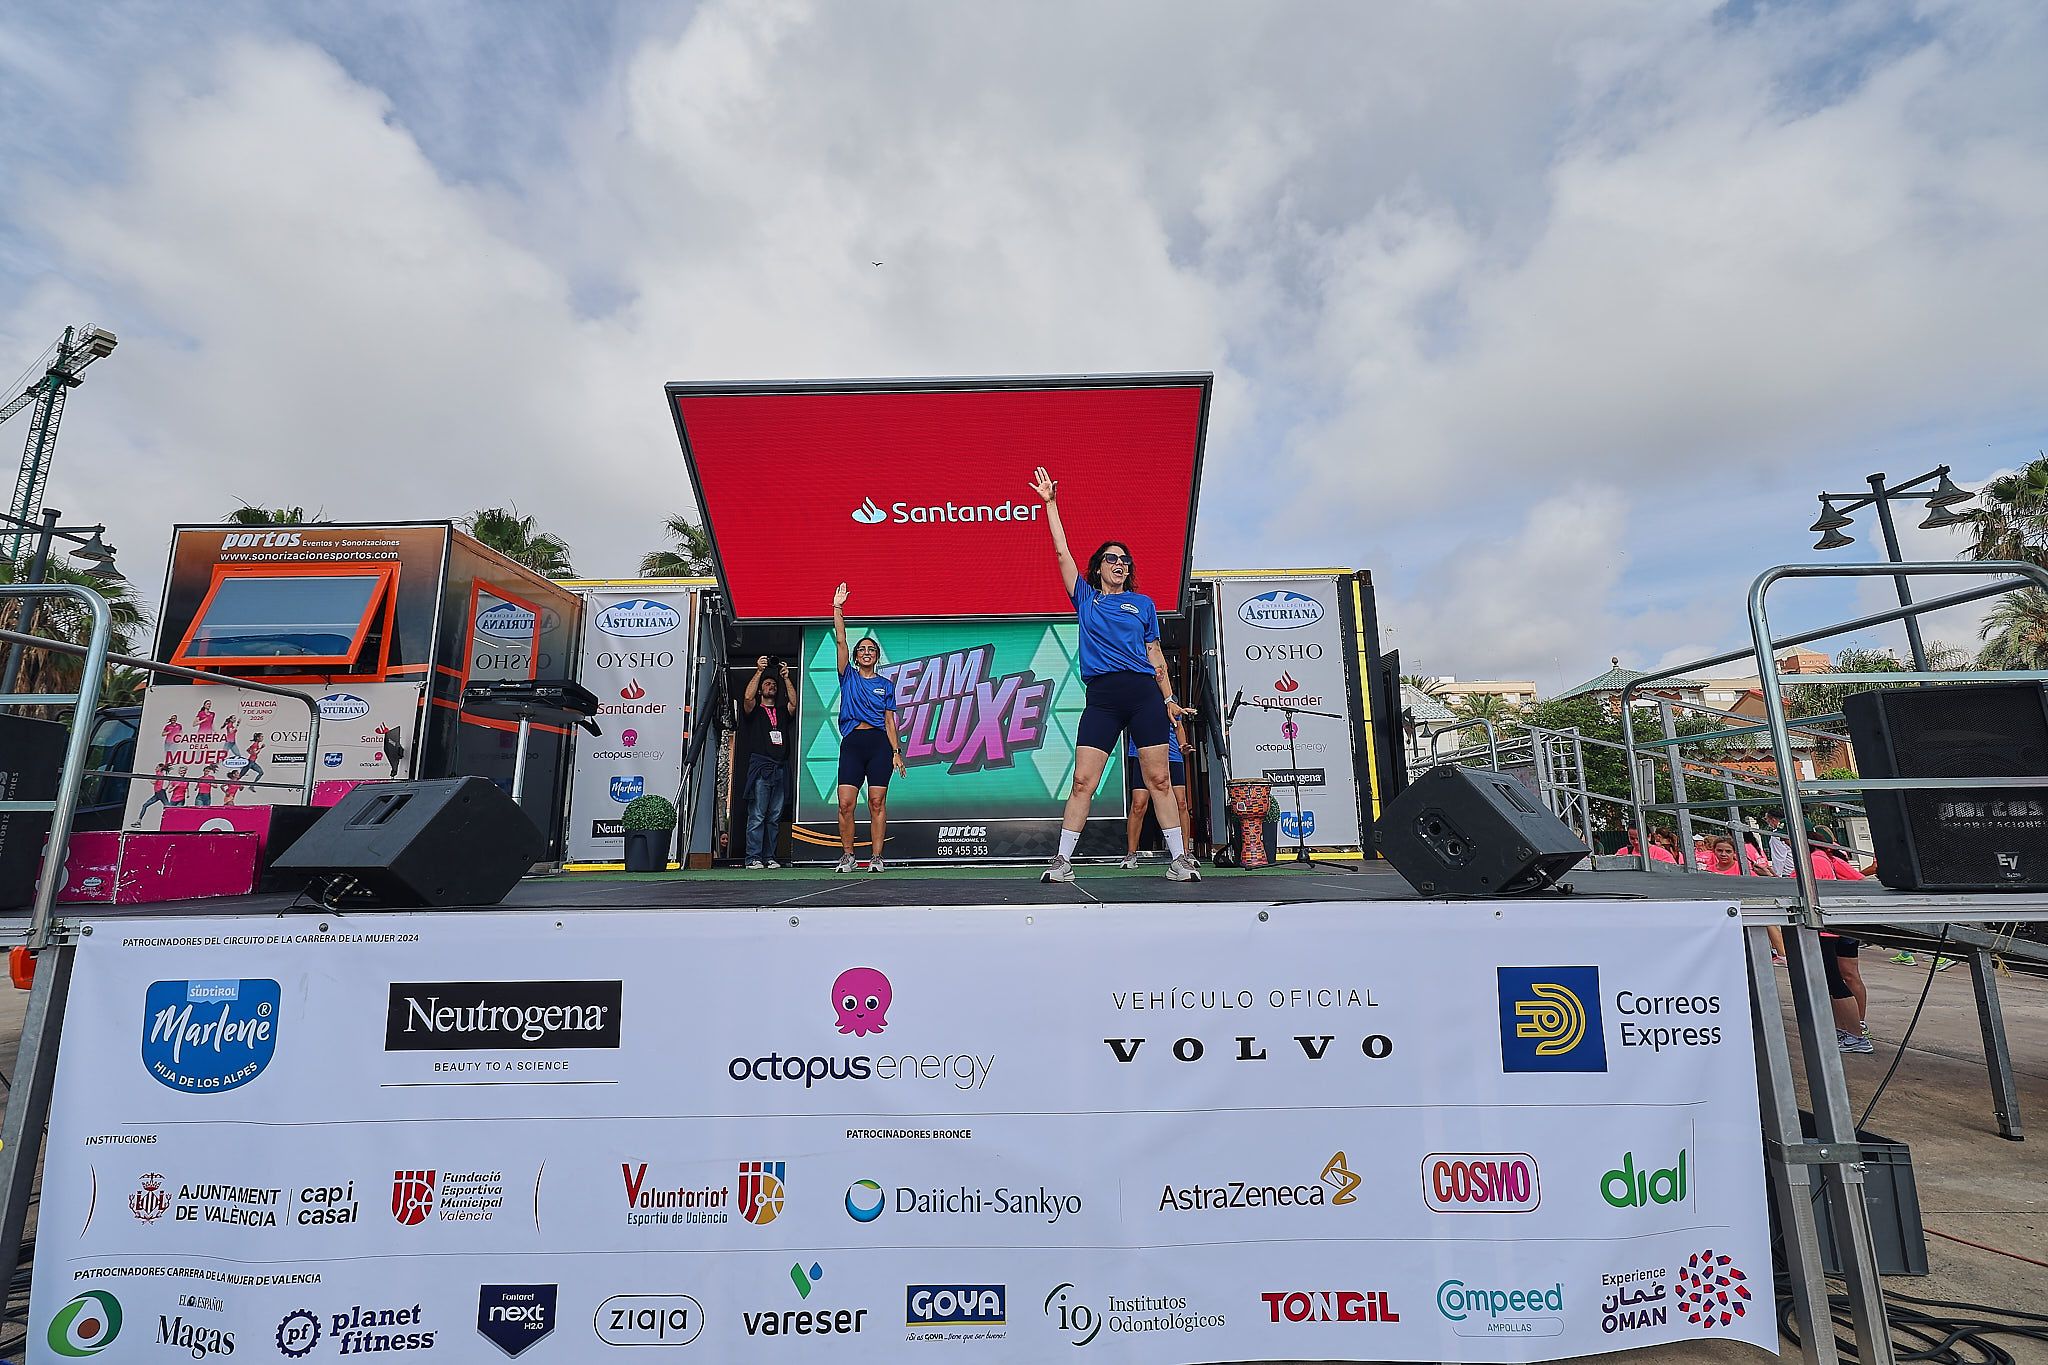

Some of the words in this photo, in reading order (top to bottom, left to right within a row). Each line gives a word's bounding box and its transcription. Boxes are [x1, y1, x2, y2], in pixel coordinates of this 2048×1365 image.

[892, 501, 1042, 523] Santander
[222, 532, 302, 550] portos
[220, 551, 398, 561] www.sonorizacionesportos.com
[600, 614, 674, 628] ASTURIANA
[1245, 605, 1318, 620] ASTURIANA
[596, 651, 674, 669] OYSHO
[1246, 643, 1323, 661] OYSHO
[240, 700, 277, 708] VALENCIA
[319, 706, 365, 714] STURIANA
[598, 702, 667, 715] Santander
[1253, 695, 1323, 707] Santander
[173, 733, 228, 744] CARRERA
[270, 731, 309, 742] OYSH
[361, 735, 383, 743] Santa
[165, 750, 229, 765] MUJER
[938, 825, 987, 838] portos
[937, 845, 953, 856] 696
[955, 845, 971, 856] 455
[972, 845, 988, 856] 353
[1997, 853, 2019, 870] EV
[122, 937, 201, 947] PATROCINADORES
[204, 936, 221, 945] DEL
[223, 936, 265, 945] CIRCUITO
[266, 935, 280, 944] DE
[281, 935, 293, 944] LA
[295, 934, 337, 943] CARRERA
[338, 934, 350, 943] DE
[352, 934, 363, 943] LA
[365, 934, 396, 943] MUJER
[397, 934, 419, 942] 2024
[1112, 987, 1254, 1010] VEHÍCULO
[1269, 988, 1379, 1008] OFICIAL
[1616, 991, 1721, 1015] Correos
[403, 996, 605, 1042] Neutrogena
[150, 1003, 271, 1064] Marlene
[1620, 1022, 1721, 1052] Express
[1103, 1034, 1393, 1063] VOLVO
[154, 1061, 176, 1081] HIJA
[179, 1075, 195, 1087] DE
[197, 1077, 220, 1088] LOS
[223, 1061, 258, 1085] ALPES
[433, 1062, 481, 1072] BEAUTY
[485, 1061, 501, 1071] TO
[505, 1061, 513, 1071] A
[516, 1061, 570, 1071] SCIENCE
[85, 1135, 158, 1146] INSTITUCIONES
[846, 1129, 931, 1139] PATROCINADORES
[933, 1129, 972, 1139] BRONCE
[442, 1171, 501, 1183] Fundació
[621, 1163, 729, 1209] Voluntariat
[1433, 1161, 1531, 1203] COSMO
[1600, 1148, 1687, 1208] dial
[178, 1184, 282, 1205] AJUNTAMENT
[300, 1186, 344, 1208] cap
[346, 1180, 354, 1201] i
[441, 1184, 503, 1198] Esportiva
[1159, 1182, 1325, 1211] AstraZeneca
[440, 1196, 503, 1210] Municipal
[895, 1186, 1082, 1223] Daiichi-Sankyo
[175, 1205, 199, 1222] DE
[204, 1205, 277, 1227] VALÈNCIA
[297, 1202, 358, 1225] casal
[439, 1210, 493, 1221] València
[627, 1212, 669, 1227] Esportiu
[671, 1211, 683, 1224] de
[686, 1211, 728, 1225] València
[73, 1267, 165, 1281] PATROCINADORES
[167, 1267, 205, 1279] CARRERA
[206, 1270, 217, 1281] DE
[216, 1272, 226, 1283] LA
[226, 1273, 255, 1286] MUJER
[255, 1275, 270, 1286] DE
[272, 1273, 322, 1285] VALENCIA
[1602, 1268, 1666, 1286] Experience
[179, 1294, 187, 1307] EL
[197, 1296, 224, 1312] ESPAÑOL
[911, 1290, 1001, 1320] GOYA
[1108, 1295, 1187, 1312] Institutos
[1437, 1280, 1563, 1321] Compeed
[330, 1302, 422, 1336] planet
[489, 1303, 545, 1322] next
[1058, 1294, 1092, 1331] io
[1601, 1306, 1667, 1334] OMAN
[610, 1309, 688, 1339] ziaja
[743, 1309, 868, 1336] vareser
[1109, 1313, 1225, 1333] Odontológicos
[1487, 1322, 1533, 1333] AMPOLLAS
[156, 1314, 235, 1360] Magas
[286, 1323, 311, 1345] pf
[339, 1329, 436, 1354] fitness
